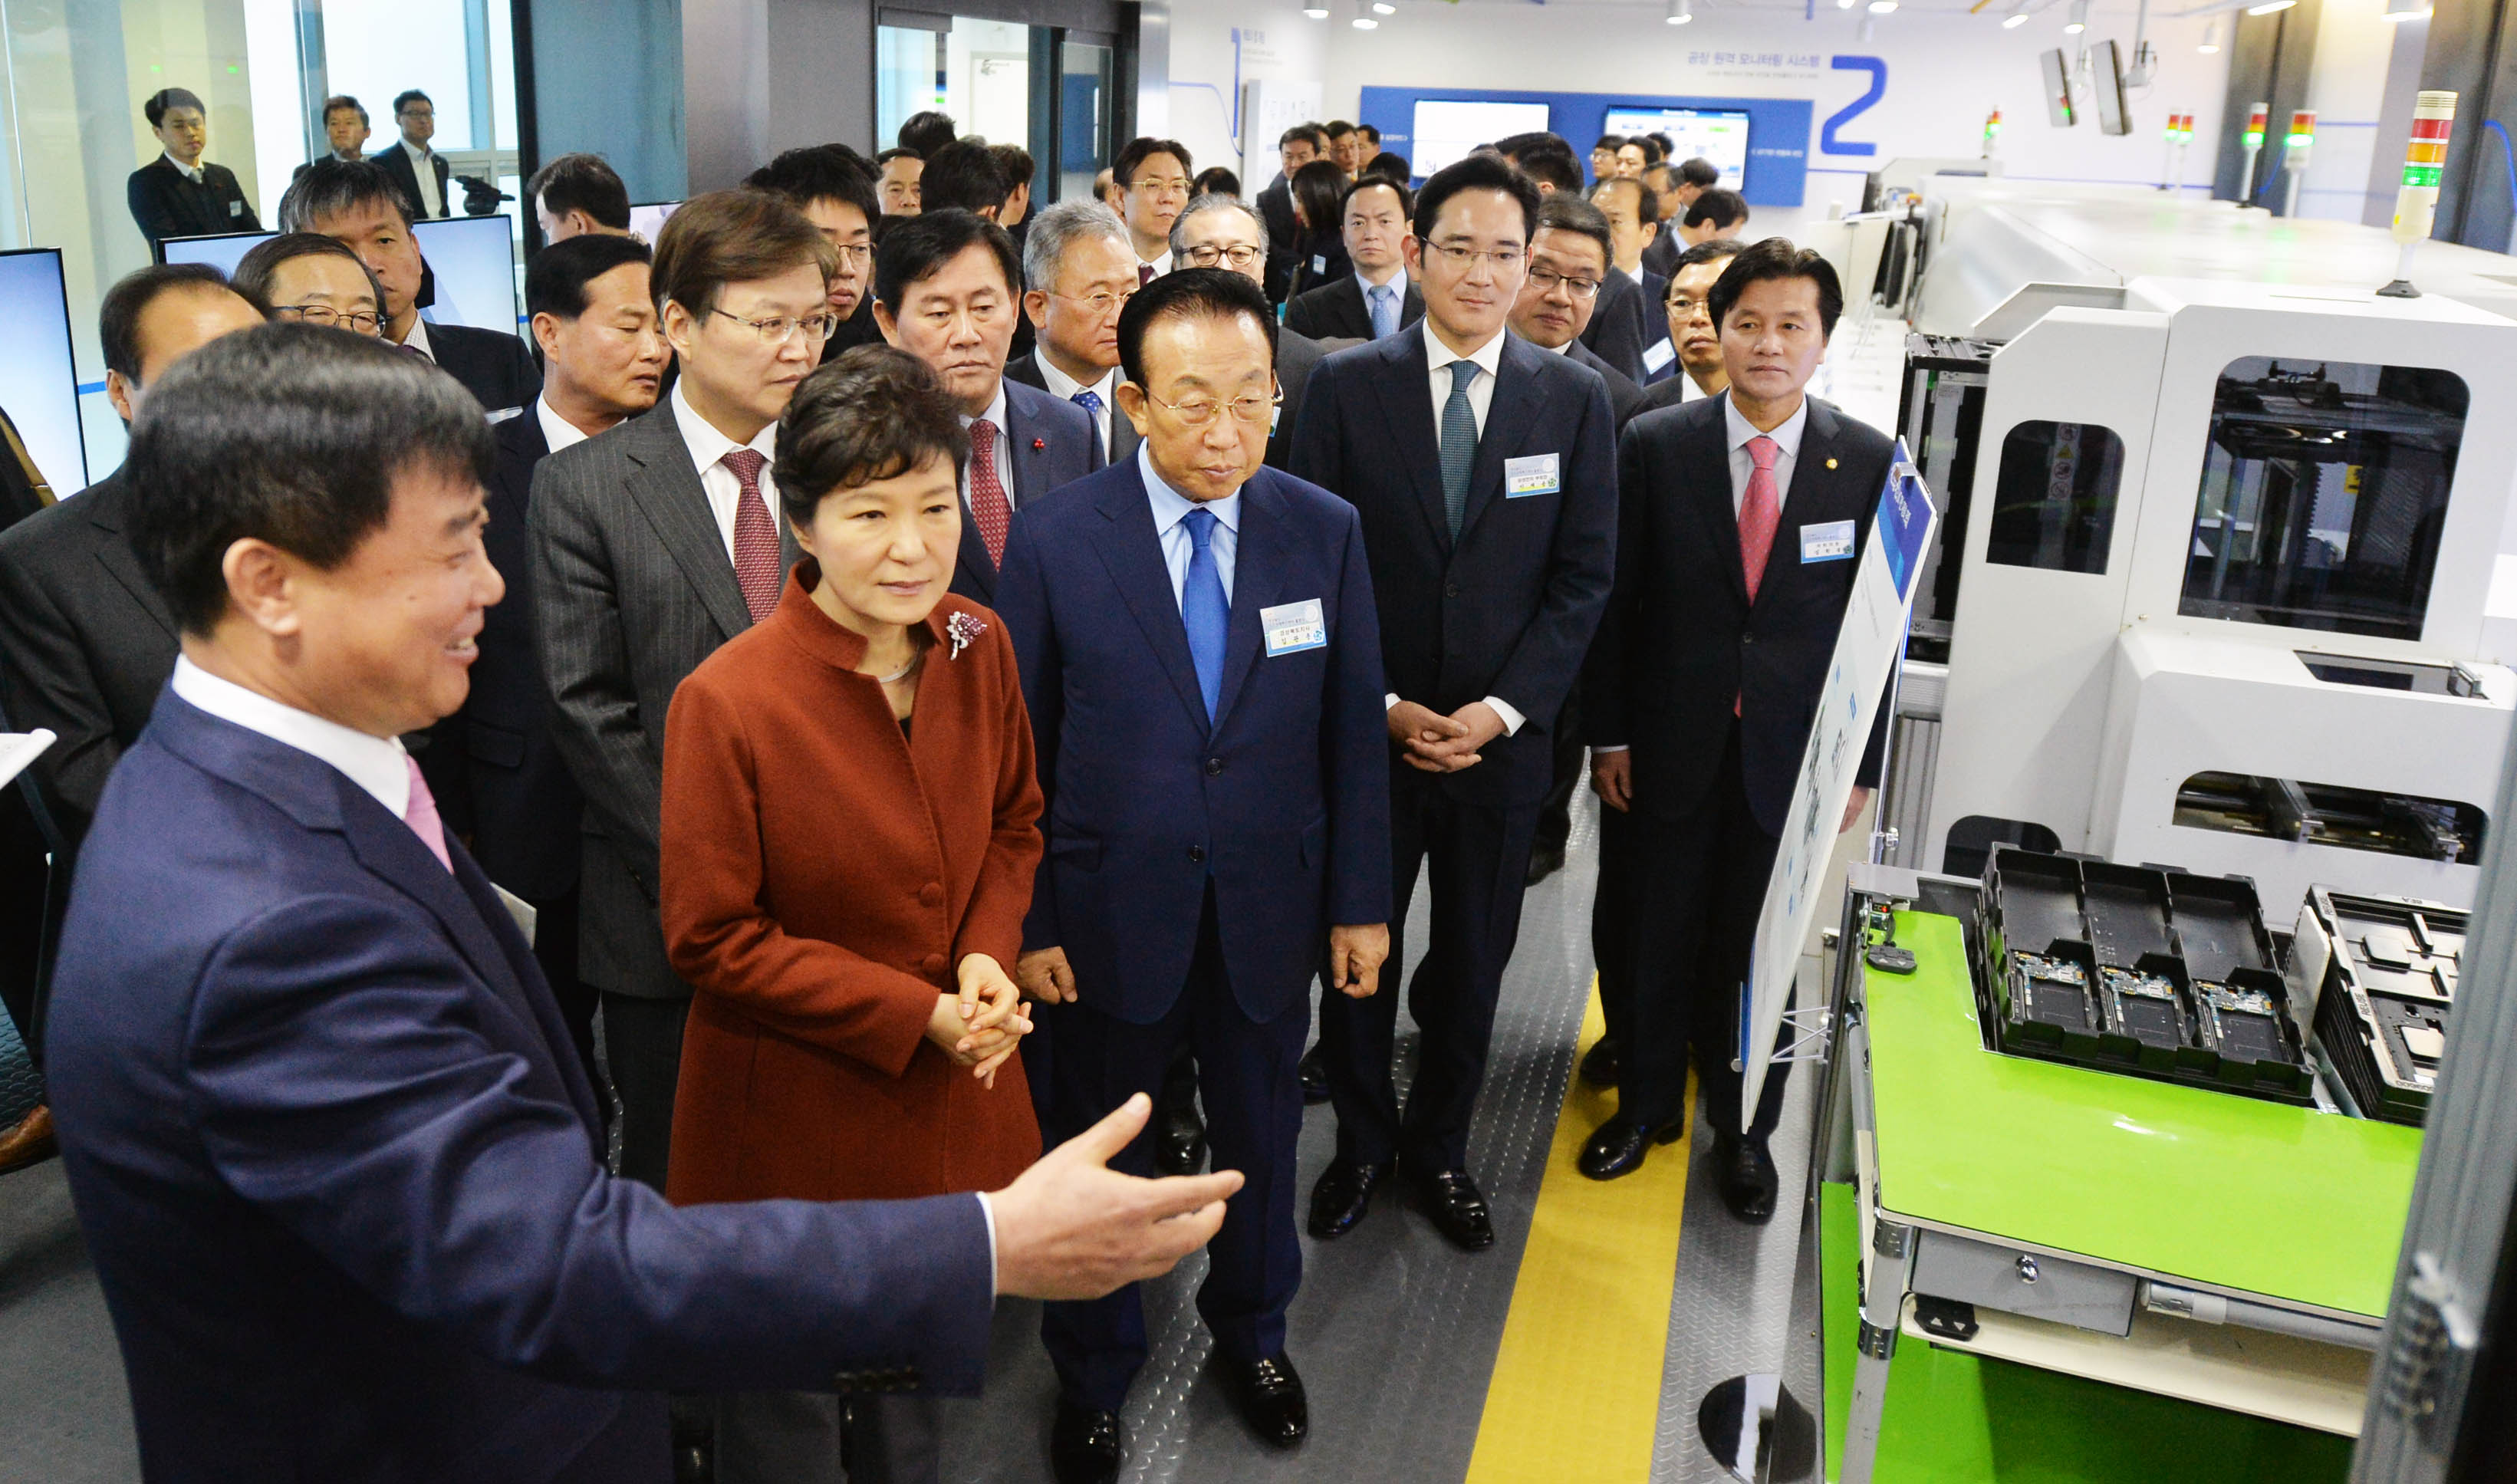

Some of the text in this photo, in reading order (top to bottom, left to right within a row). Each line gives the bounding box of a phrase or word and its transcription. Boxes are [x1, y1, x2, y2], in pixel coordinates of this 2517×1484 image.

[1687, 51, 1709, 64] 공장
[1739, 53, 1782, 67] 모니터링
[1787, 54, 1821, 67] 시스템
[1821, 55, 1887, 156] 2
[2354, 992, 2371, 1016] REUSE
